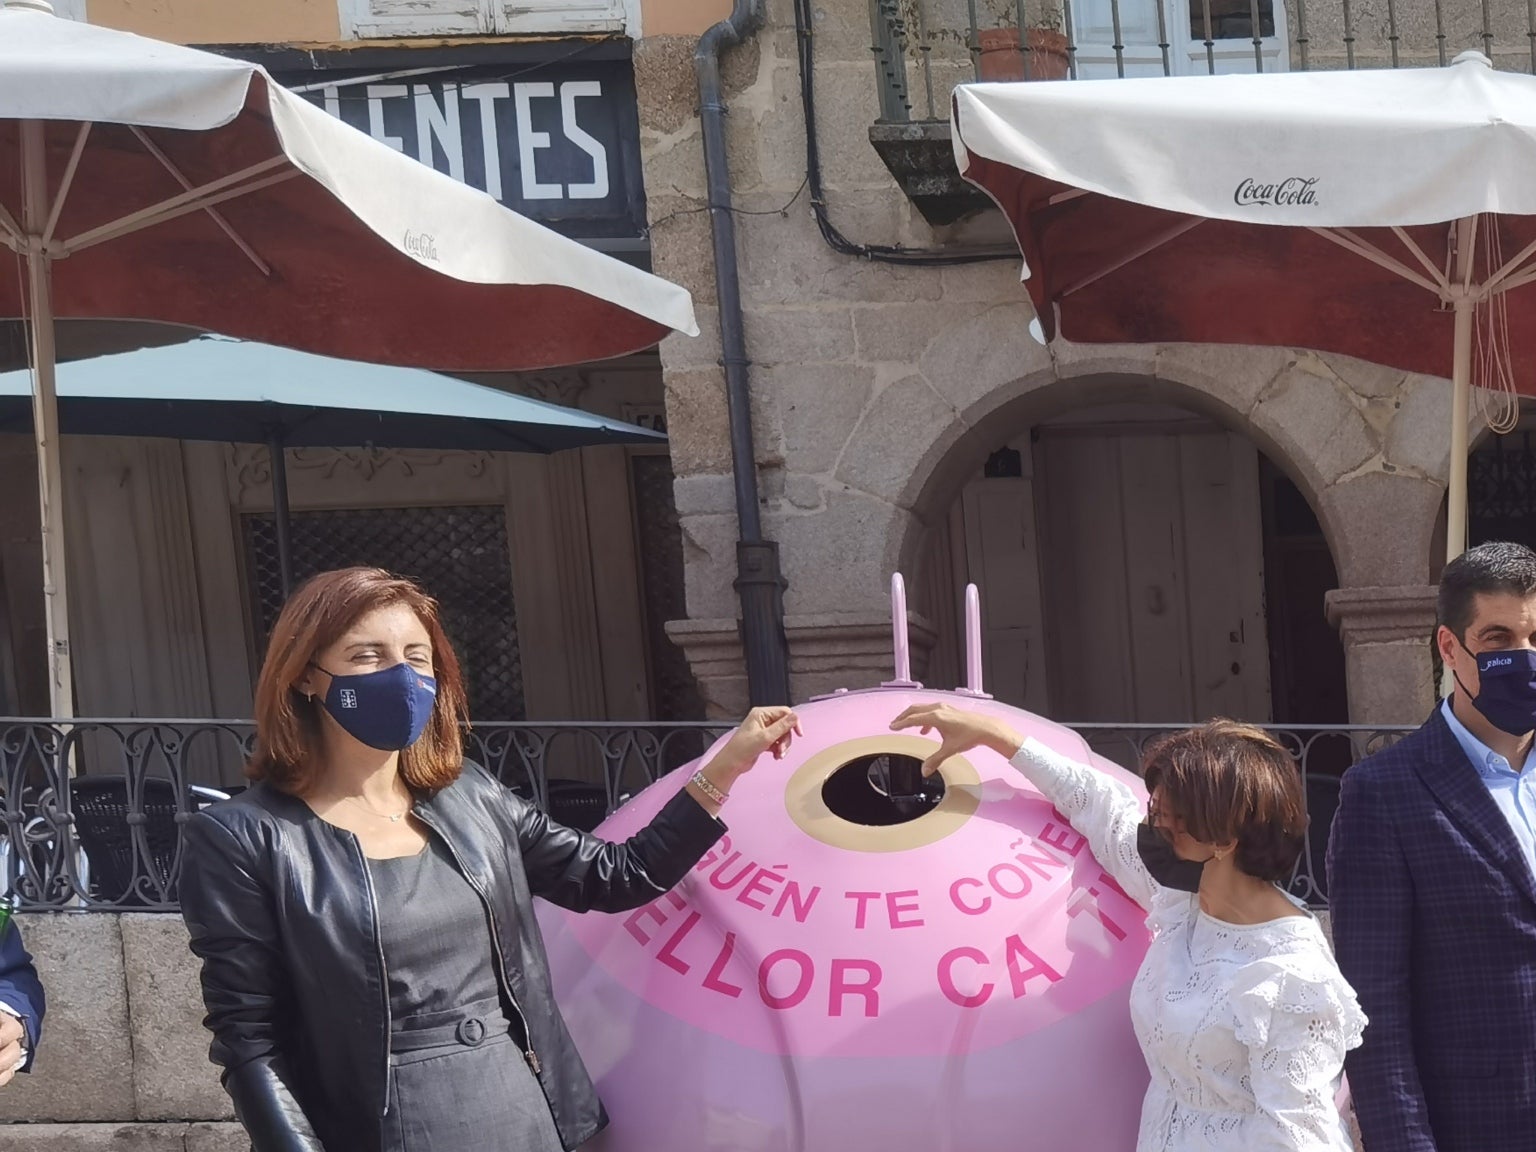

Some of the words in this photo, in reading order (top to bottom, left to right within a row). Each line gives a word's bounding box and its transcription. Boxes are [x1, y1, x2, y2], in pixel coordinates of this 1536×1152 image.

[1233, 177, 1320, 206] Coca-Cola
[845, 890, 925, 930] TE
[937, 934, 1065, 1009] CA
